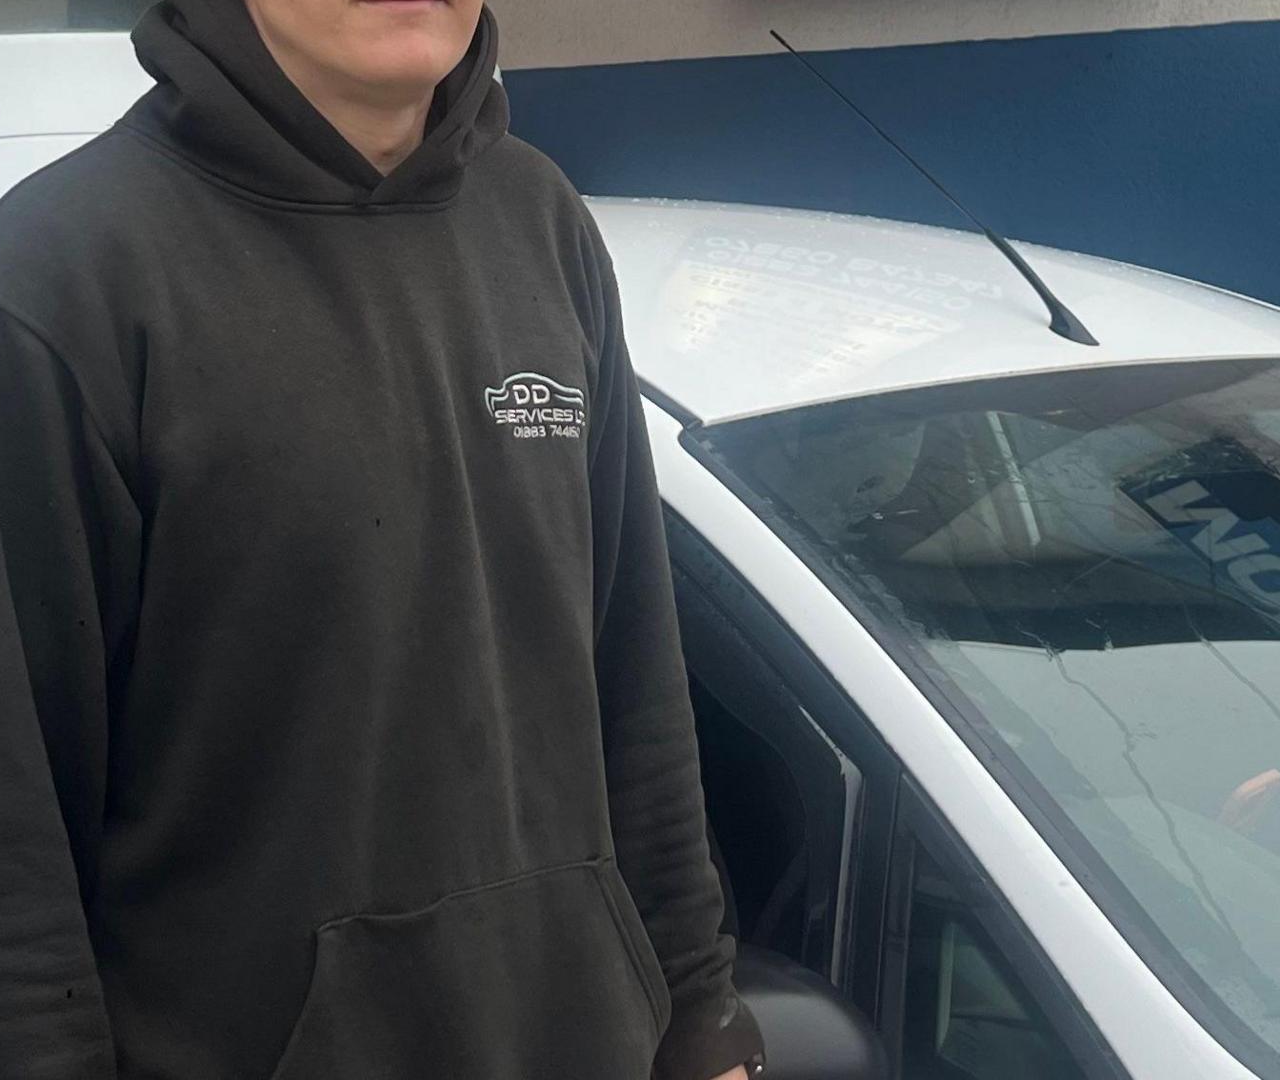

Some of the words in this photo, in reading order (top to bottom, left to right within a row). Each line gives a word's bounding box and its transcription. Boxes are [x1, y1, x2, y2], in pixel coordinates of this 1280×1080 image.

[512, 384, 551, 405] DD
[494, 408, 573, 424] SERVICES
[513, 425, 546, 438] 01883
